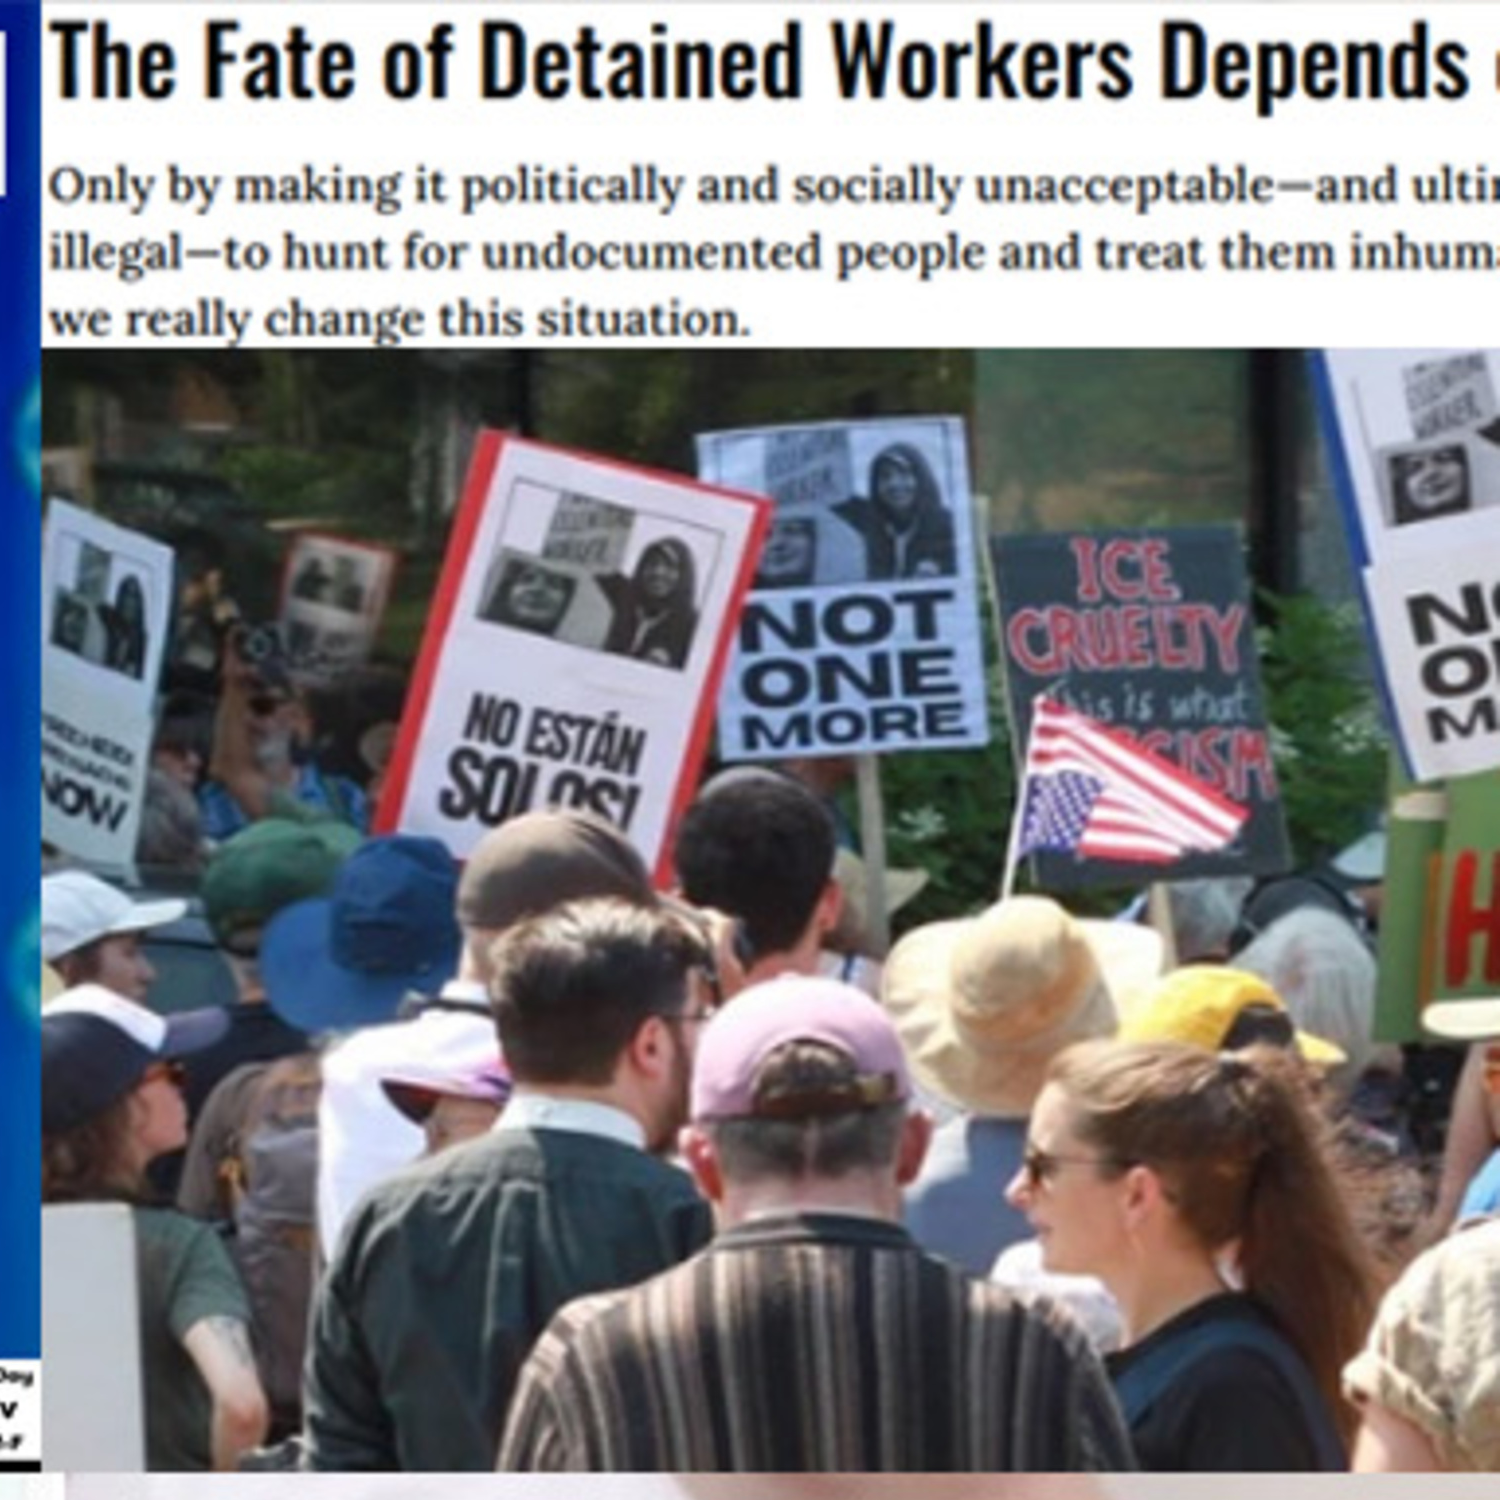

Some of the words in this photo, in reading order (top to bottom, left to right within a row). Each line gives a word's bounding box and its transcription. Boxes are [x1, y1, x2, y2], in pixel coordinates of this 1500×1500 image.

[1071, 536, 1182, 602] ICE
[741, 590, 954, 653] NOT
[1008, 603, 1247, 675] CRUELTY
[741, 651, 961, 709] ONE
[462, 692, 522, 748] NO
[524, 711, 647, 778] ESTÁN
[741, 702, 969, 750] MORE
